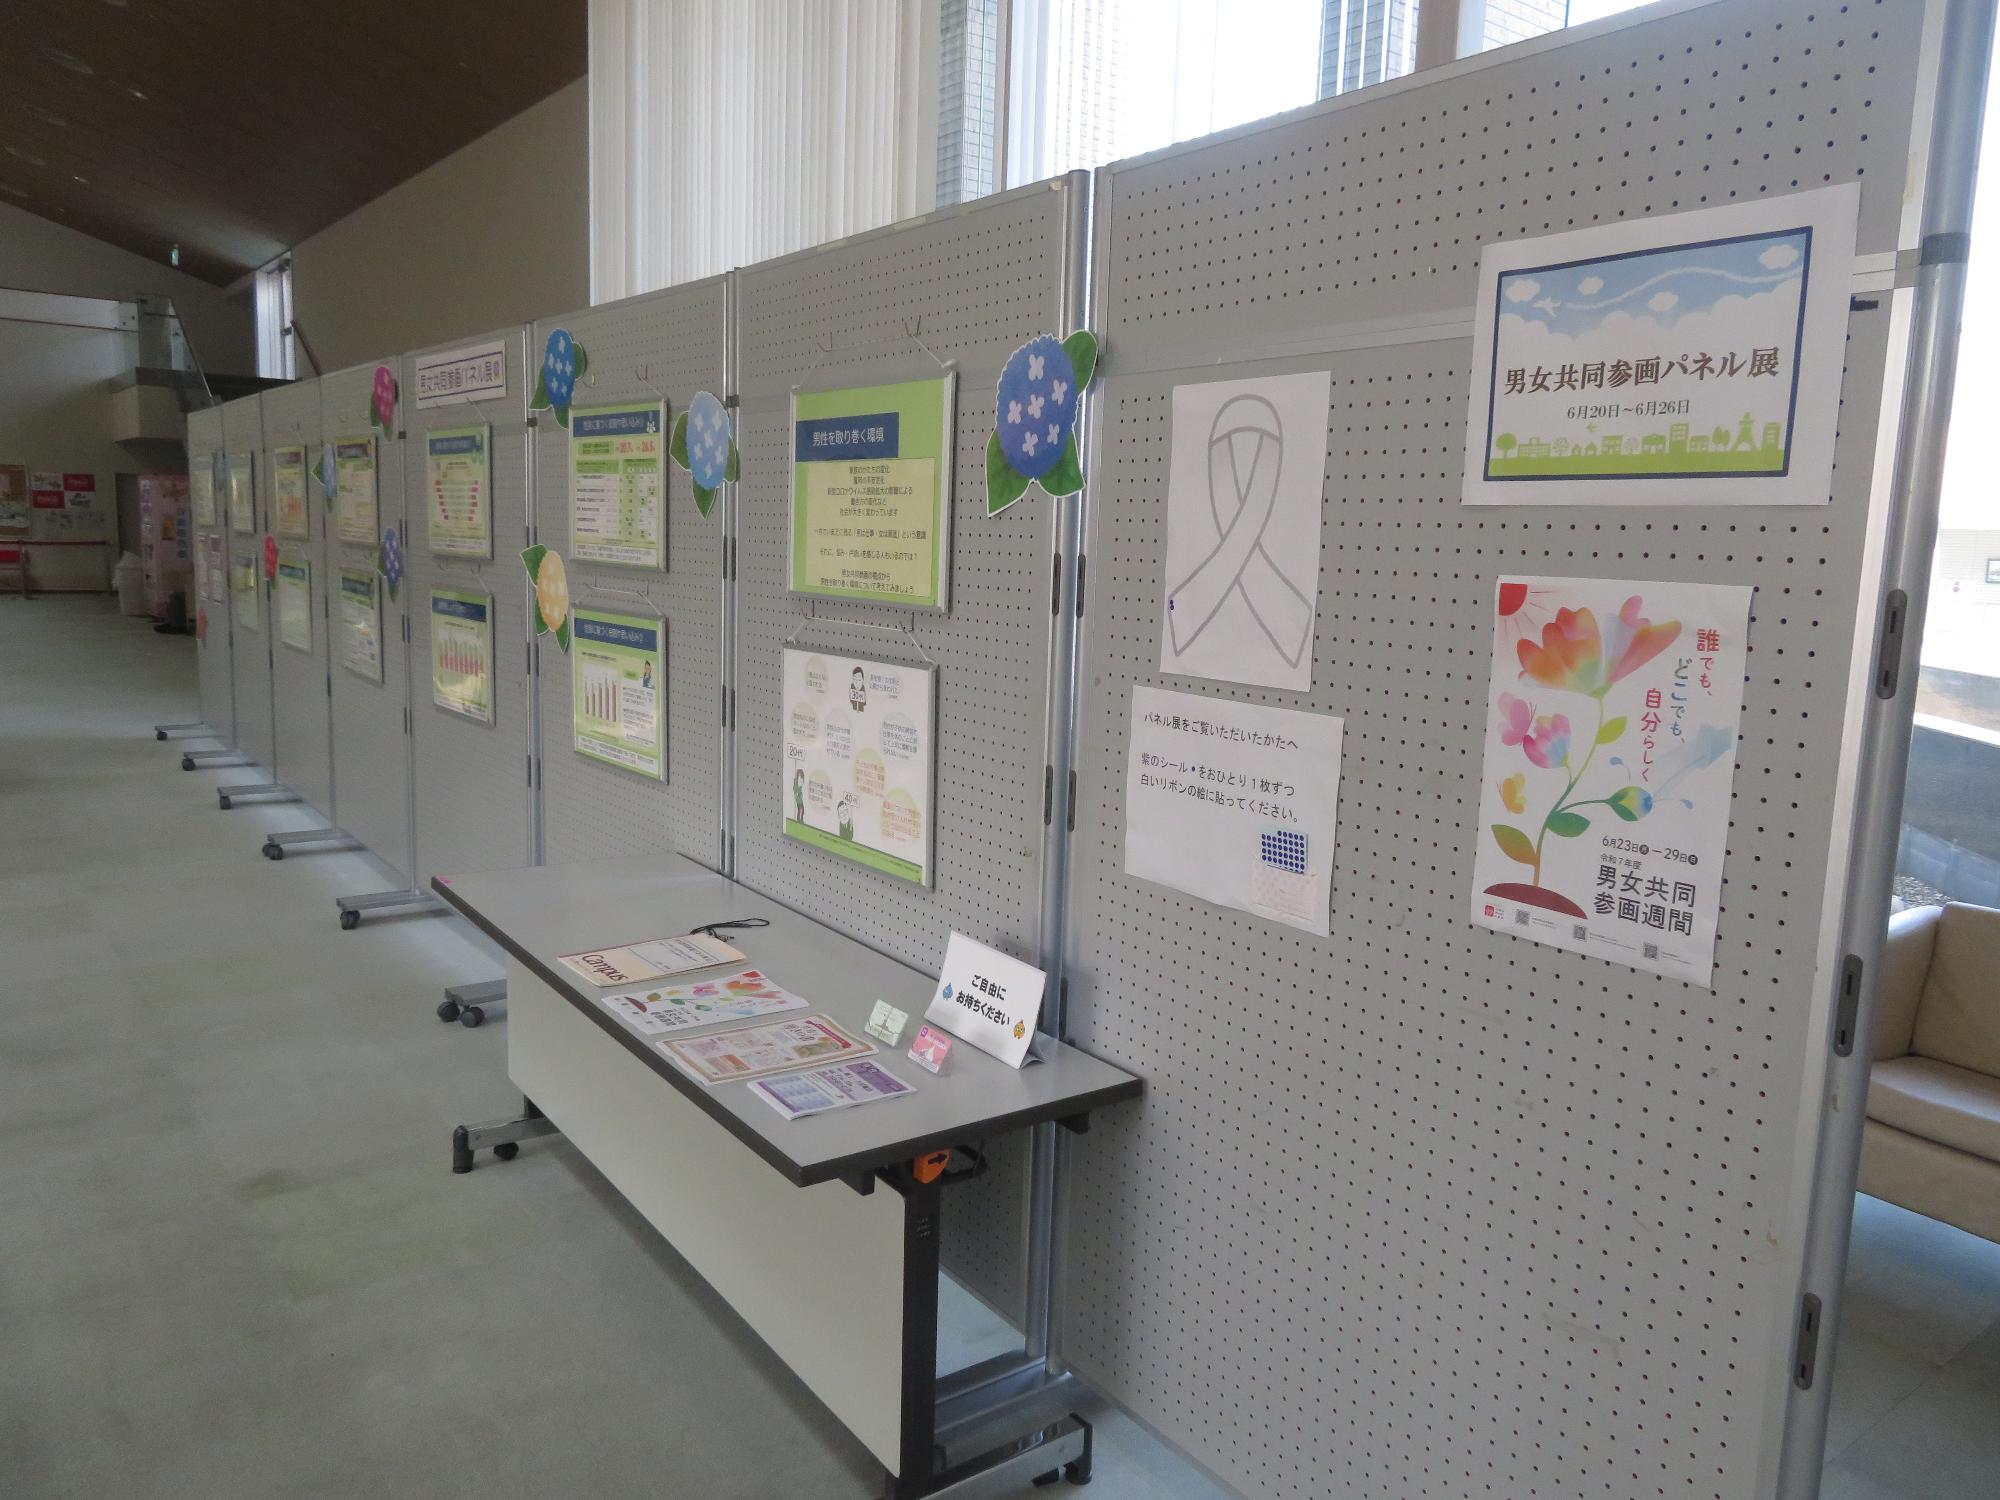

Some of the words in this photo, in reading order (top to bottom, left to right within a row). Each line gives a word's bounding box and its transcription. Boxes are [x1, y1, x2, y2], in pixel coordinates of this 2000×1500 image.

[1504, 346, 1780, 395] 男女共同参画パネル展
[812, 426, 885, 447] 男性を取り巻く環境
[1144, 711, 1299, 750] パネル展をご覧いただいたかたへ
[1641, 688, 1662, 782] 自分らしく
[1140, 773, 1298, 823] 白いリボンの絵に貼ってください。
[1596, 864, 1696, 908] 男女共同
[1593, 891, 1694, 936] 参画週間
[581, 954, 630, 982] Campus
[971, 974, 1007, 1001] ご自由に
[956, 989, 1010, 1025] お持ちください
